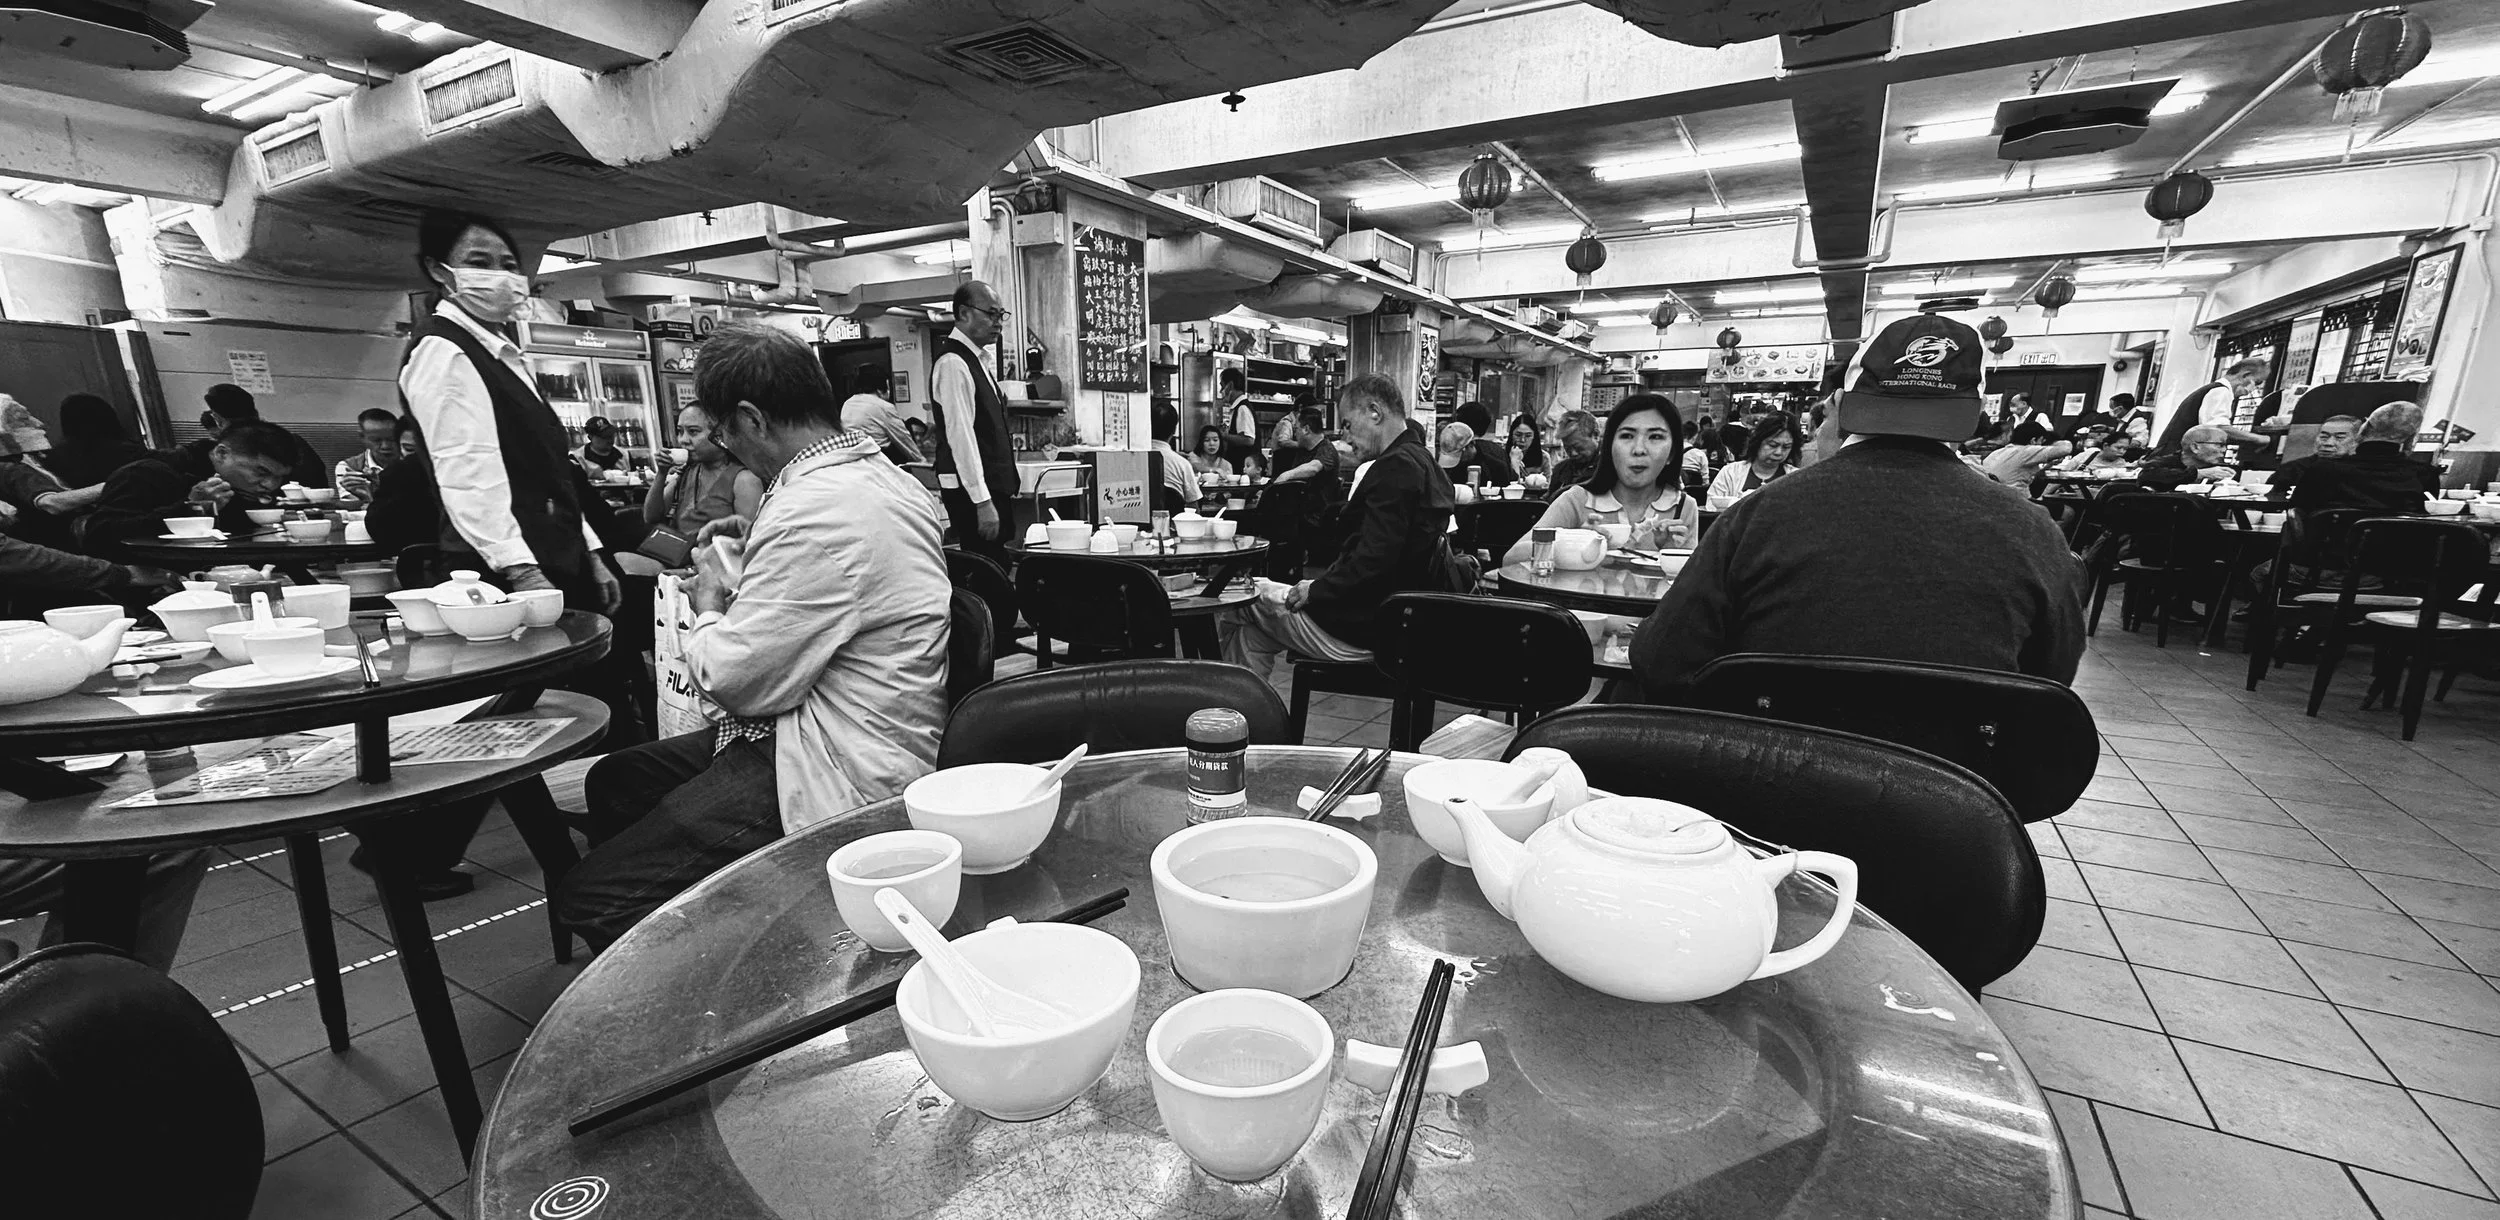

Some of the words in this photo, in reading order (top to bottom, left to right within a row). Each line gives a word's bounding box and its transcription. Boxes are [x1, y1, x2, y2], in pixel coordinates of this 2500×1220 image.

[2023, 354, 2040, 364] EXIT
[2041, 354, 2057, 364] 出口
[1922, 374, 1943, 382] KONG
[1878, 380, 1936, 388] NTERNATIONAL
[1116, 486, 1140, 497] 小心地滑
[666, 669, 694, 698] FILA
